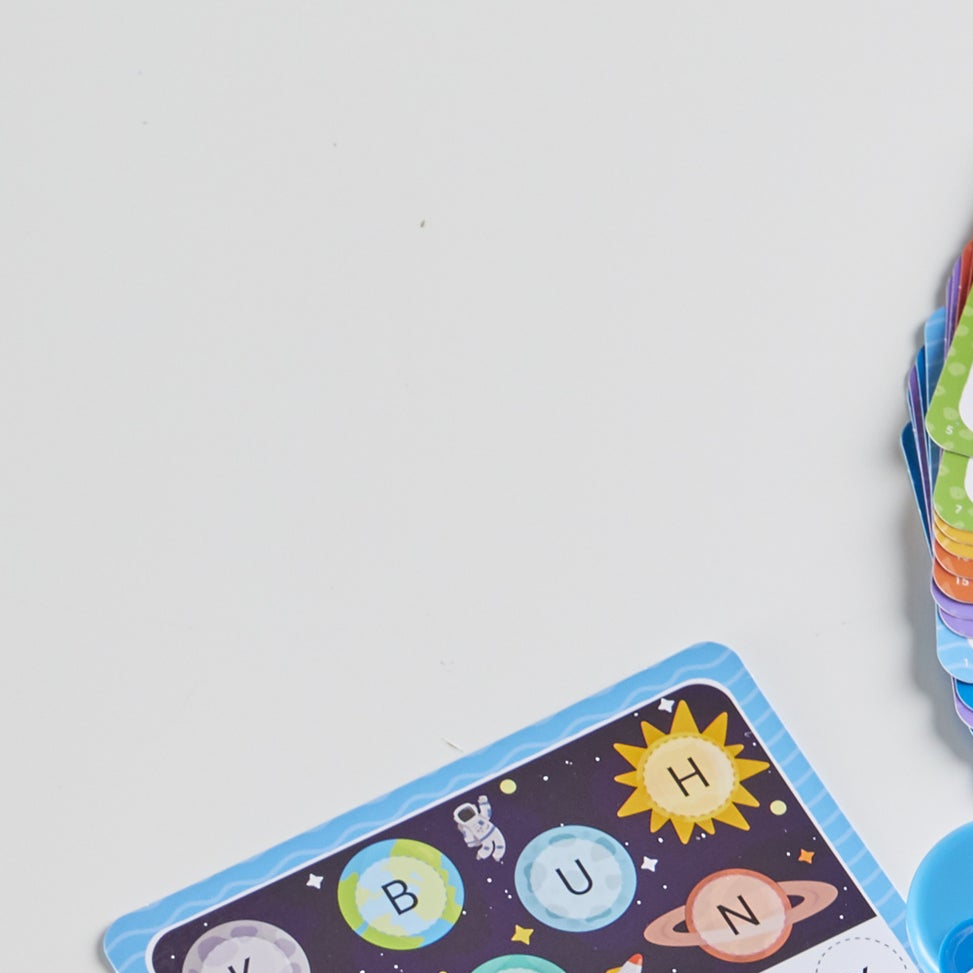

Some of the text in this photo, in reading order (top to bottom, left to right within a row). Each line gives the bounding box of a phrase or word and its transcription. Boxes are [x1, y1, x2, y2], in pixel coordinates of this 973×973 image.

[945, 425, 954, 436] 5
[954, 503, 963, 515] 7
[668, 757, 710, 797] H
[555, 859, 593, 896] U
[381, 879, 419, 916] B
[716, 900, 761, 936] N
